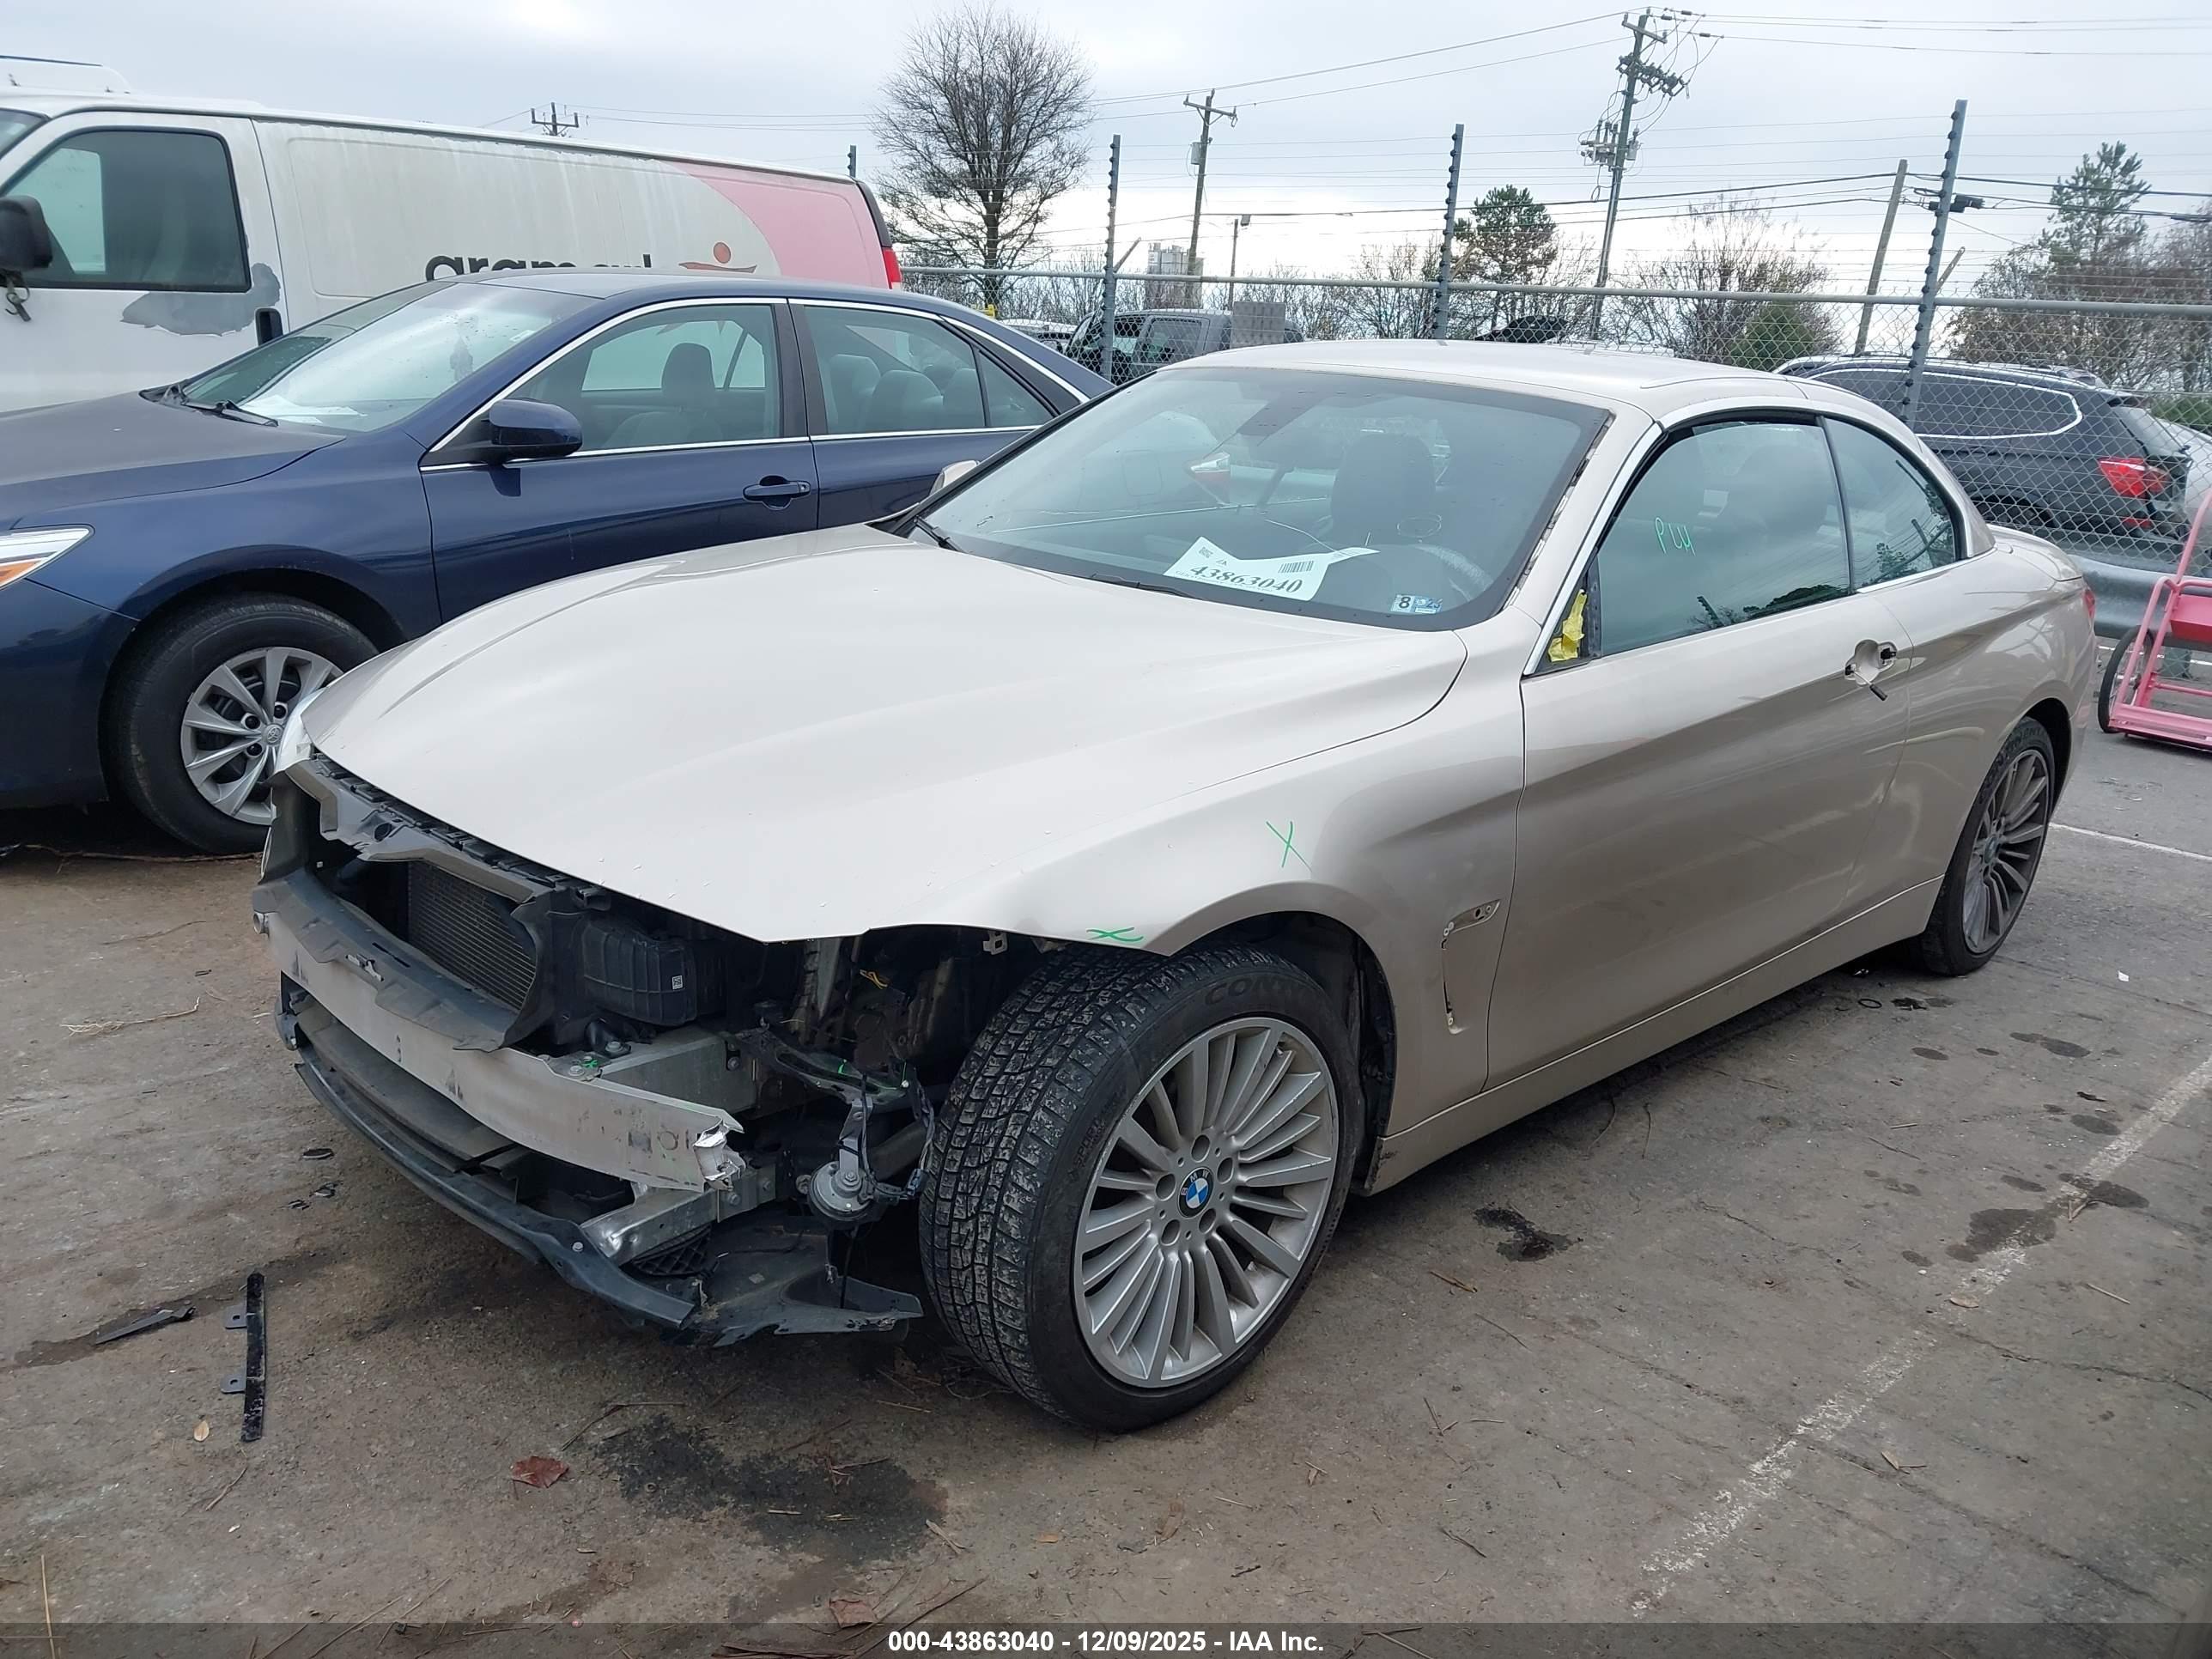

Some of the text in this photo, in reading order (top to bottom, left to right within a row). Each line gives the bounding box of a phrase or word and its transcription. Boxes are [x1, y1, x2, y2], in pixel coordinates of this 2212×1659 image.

[1190, 566, 1303, 593] 43863040
[1399, 596, 1411, 609] 8
[1181, 1169, 1210, 1196] BMW
